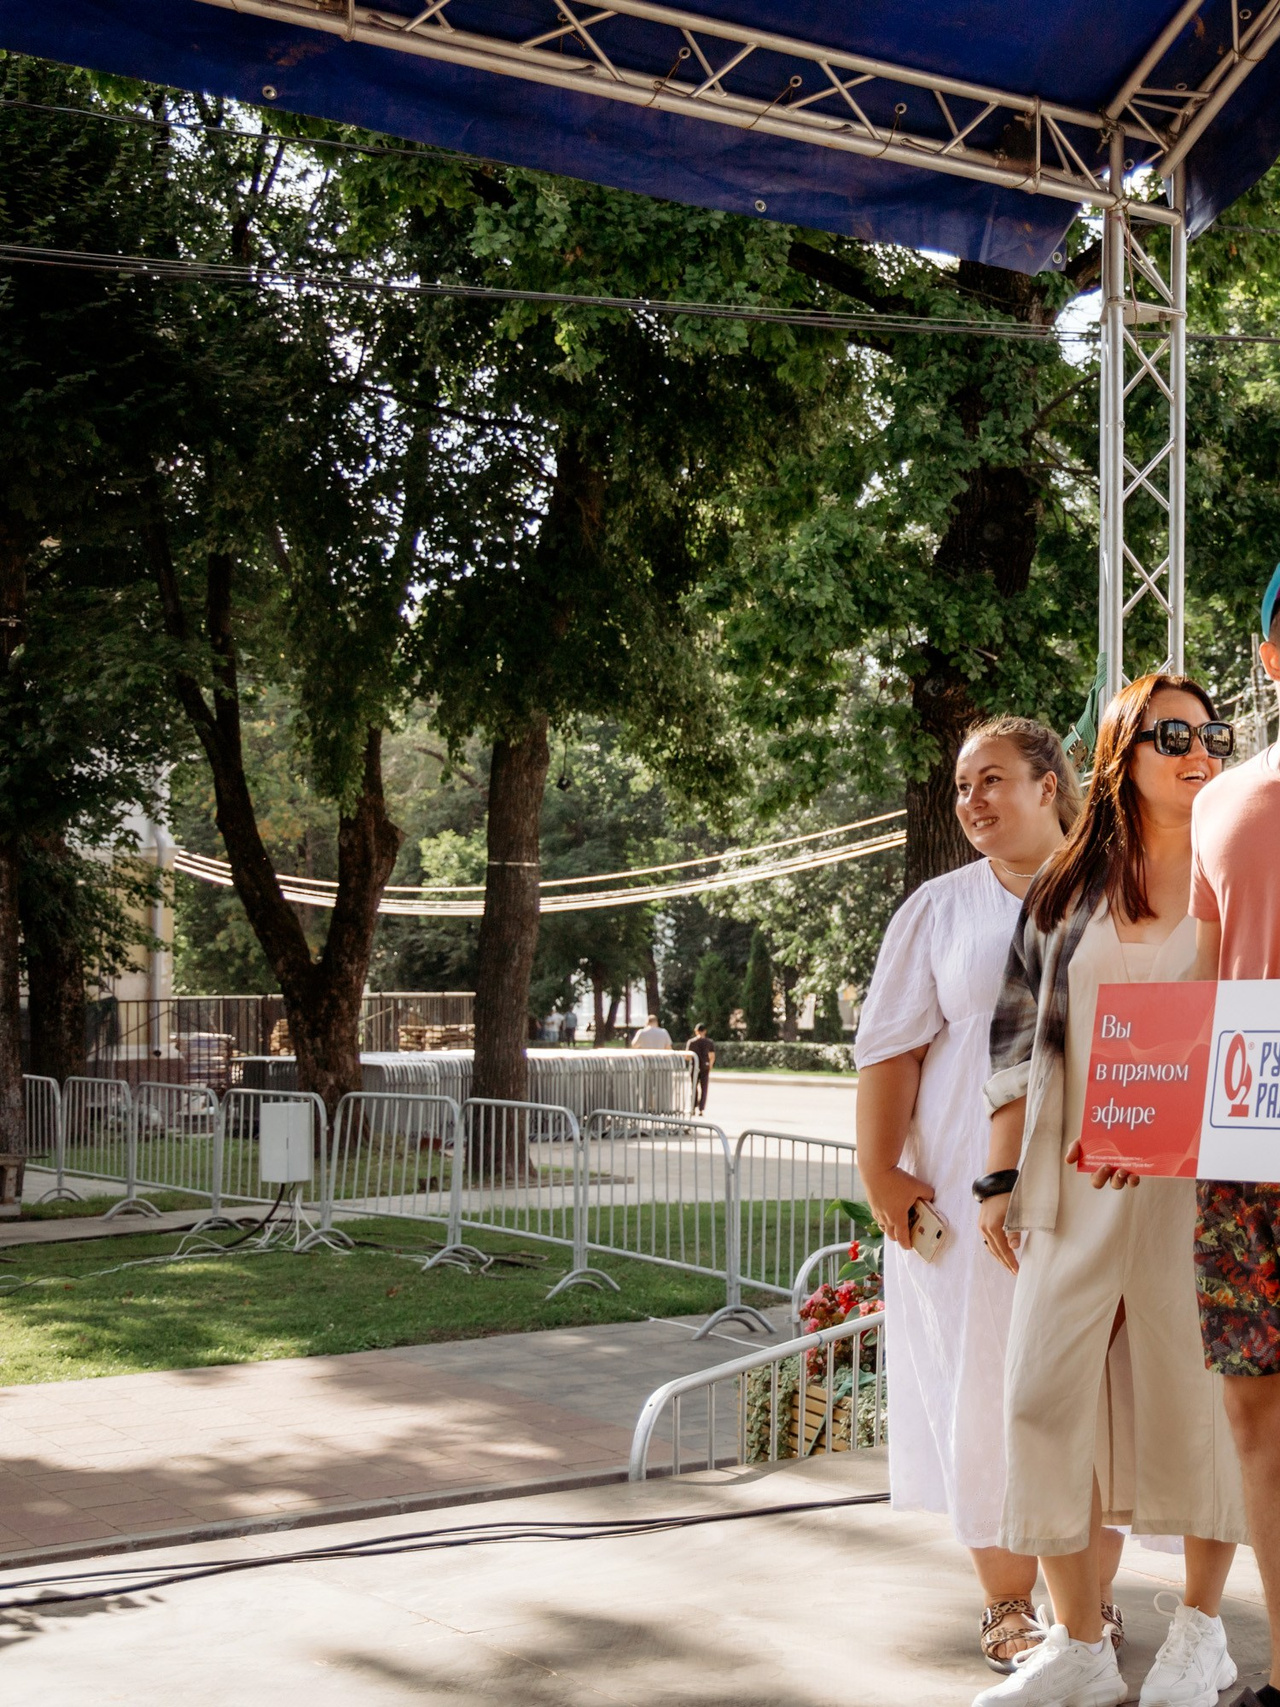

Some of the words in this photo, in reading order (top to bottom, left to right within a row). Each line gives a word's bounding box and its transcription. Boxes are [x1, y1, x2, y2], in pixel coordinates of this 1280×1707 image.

[1101, 1014, 1131, 1039] Вы
[1096, 1063, 1107, 1080] в
[1111, 1063, 1189, 1087] прямом
[1090, 1097, 1156, 1130] эфире
